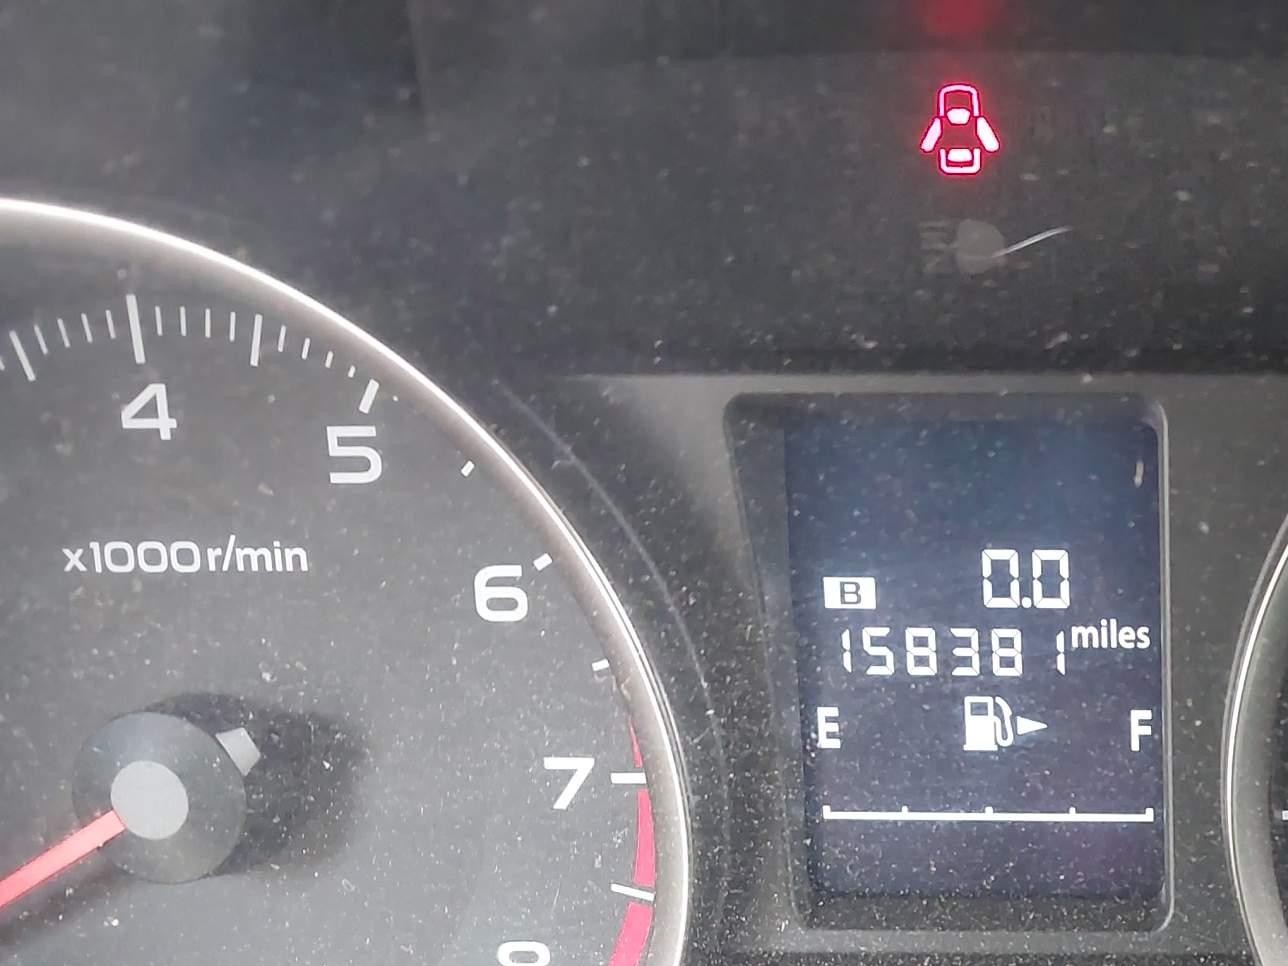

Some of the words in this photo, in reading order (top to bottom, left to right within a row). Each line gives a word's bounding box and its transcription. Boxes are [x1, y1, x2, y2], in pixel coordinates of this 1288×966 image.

[121, 383, 177, 439] 4
[327, 426, 382, 484] 5
[63, 541, 200, 573] x1000
[207, 536, 308, 573] r/min
[982, 549, 1070, 608] 0.0
[474, 565, 529, 622] 6
[841, 627, 1066, 676] 158381
[1072, 619, 1150, 649] miles
[817, 707, 841, 749] E
[1130, 710, 1152, 750] F
[544, 757, 594, 809] 7
